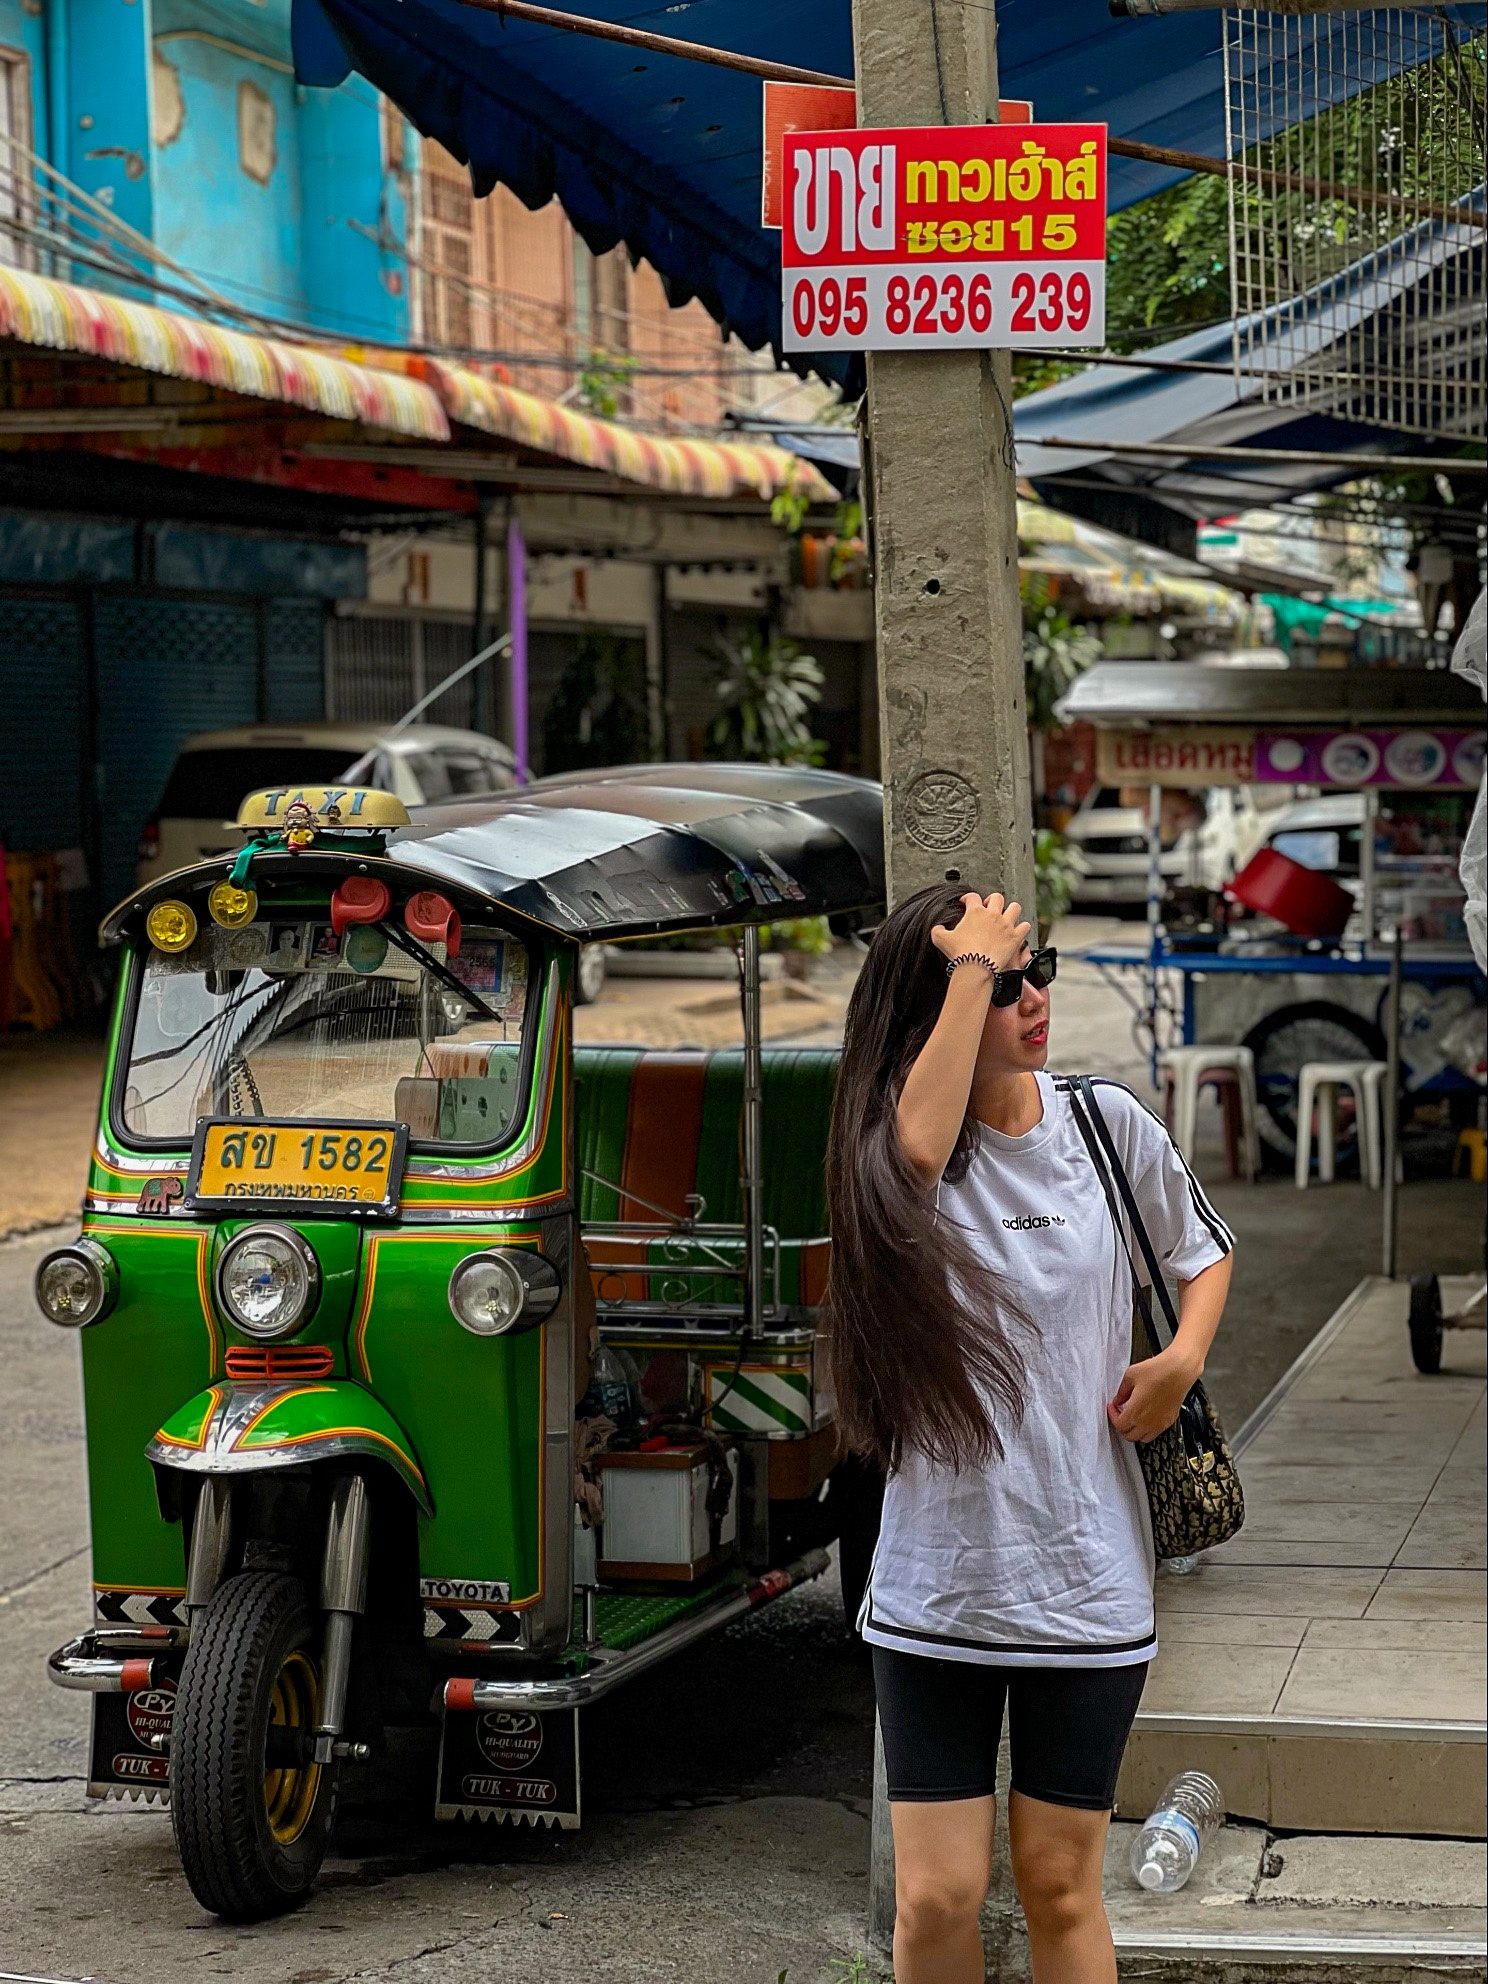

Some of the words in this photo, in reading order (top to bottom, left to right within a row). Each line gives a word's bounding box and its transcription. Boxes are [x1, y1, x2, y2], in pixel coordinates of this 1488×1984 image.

[905, 140, 1098, 204] ทาวเฮ้าส์
[793, 144, 897, 256] ขาย
[905, 218, 1005, 254] ซอย
[1010, 213, 1077, 251] 15
[792, 276, 869, 338] 095
[885, 272, 993, 336] 8236
[1010, 271, 1092, 333] 239
[219, 1131, 276, 1169] สข
[300, 1134, 387, 1172] 1582
[1002, 1214, 1051, 1231] adidas
[424, 1581, 504, 1601] TOYOTA
[134, 1717, 172, 1729] HI-QUAL
[485, 1736, 540, 1750] HI-QUALITY
[119, 1758, 153, 1776] TUK
[469, 1779, 502, 1796] TUK
[516, 1782, 550, 1799] TUK
